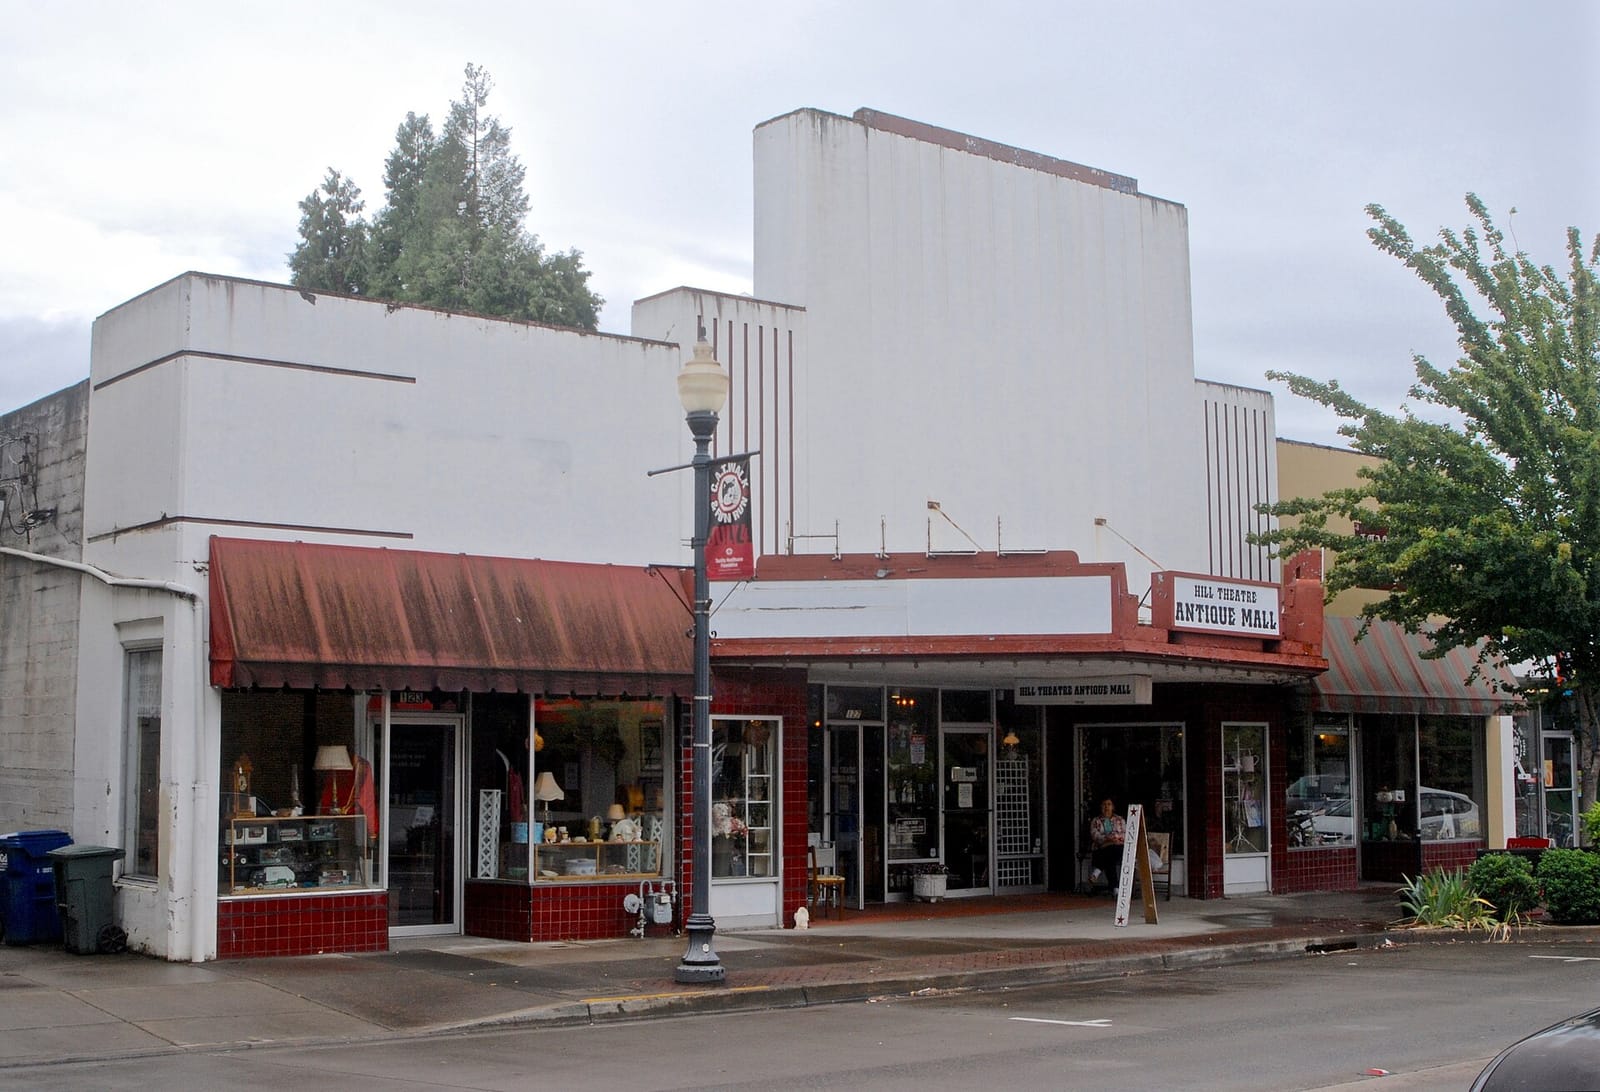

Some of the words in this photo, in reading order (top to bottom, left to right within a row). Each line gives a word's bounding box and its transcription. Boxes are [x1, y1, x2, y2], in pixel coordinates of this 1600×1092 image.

[711, 463, 749, 492] CATWALK
[711, 500, 718, 512] &
[715, 510, 732, 523] FUN
[732, 497, 748, 521] RUN
[1194, 585, 1214, 599] HILL
[1217, 588, 1257, 603] THEATRE
[1176, 602, 1236, 625] ANTIQUE
[1241, 608, 1277, 629] MALL
[1019, 686, 1036, 696] HILL
[1038, 686, 1073, 696] THEATRE
[1074, 685, 1109, 696] ANTIQUE
[1110, 684, 1131, 695] MALL
[1120, 821, 1136, 909] ANTIQUES
